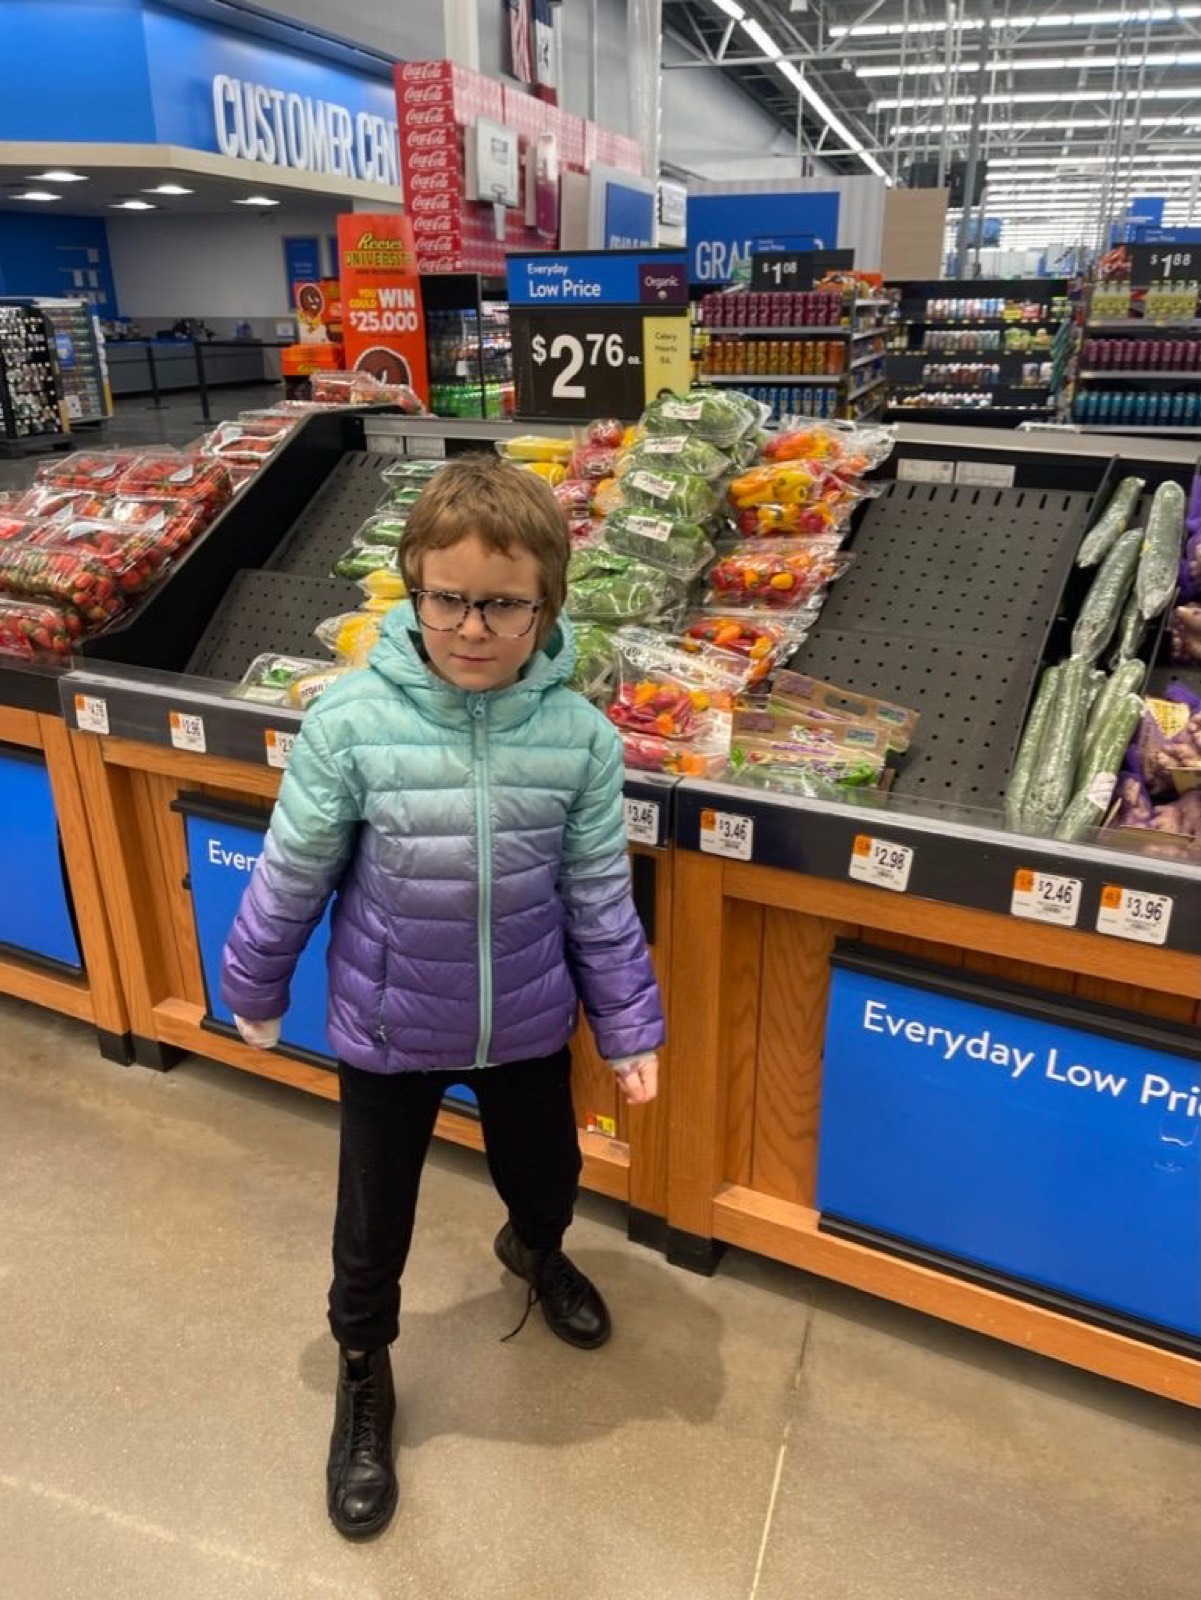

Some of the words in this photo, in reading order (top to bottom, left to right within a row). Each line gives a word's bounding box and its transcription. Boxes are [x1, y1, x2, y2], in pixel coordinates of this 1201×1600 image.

[213, 74, 356, 179] CUSTOMER
[527, 263, 569, 275] Everyday
[529, 280, 557, 298] Low
[562, 280, 601, 297] Price
[644, 276, 679, 289] Organic
[378, 289, 416, 308] WIN
[719, 819, 747, 840] $3.46
[208, 839, 257, 871] Ever
[1038, 880, 1073, 904] $2.46
[1127, 896, 1162, 921] $3.96
[863, 1000, 1035, 1078] Everyday
[1045, 1049, 1127, 1097] Low
[1139, 1074, 1201, 1117] Pri
